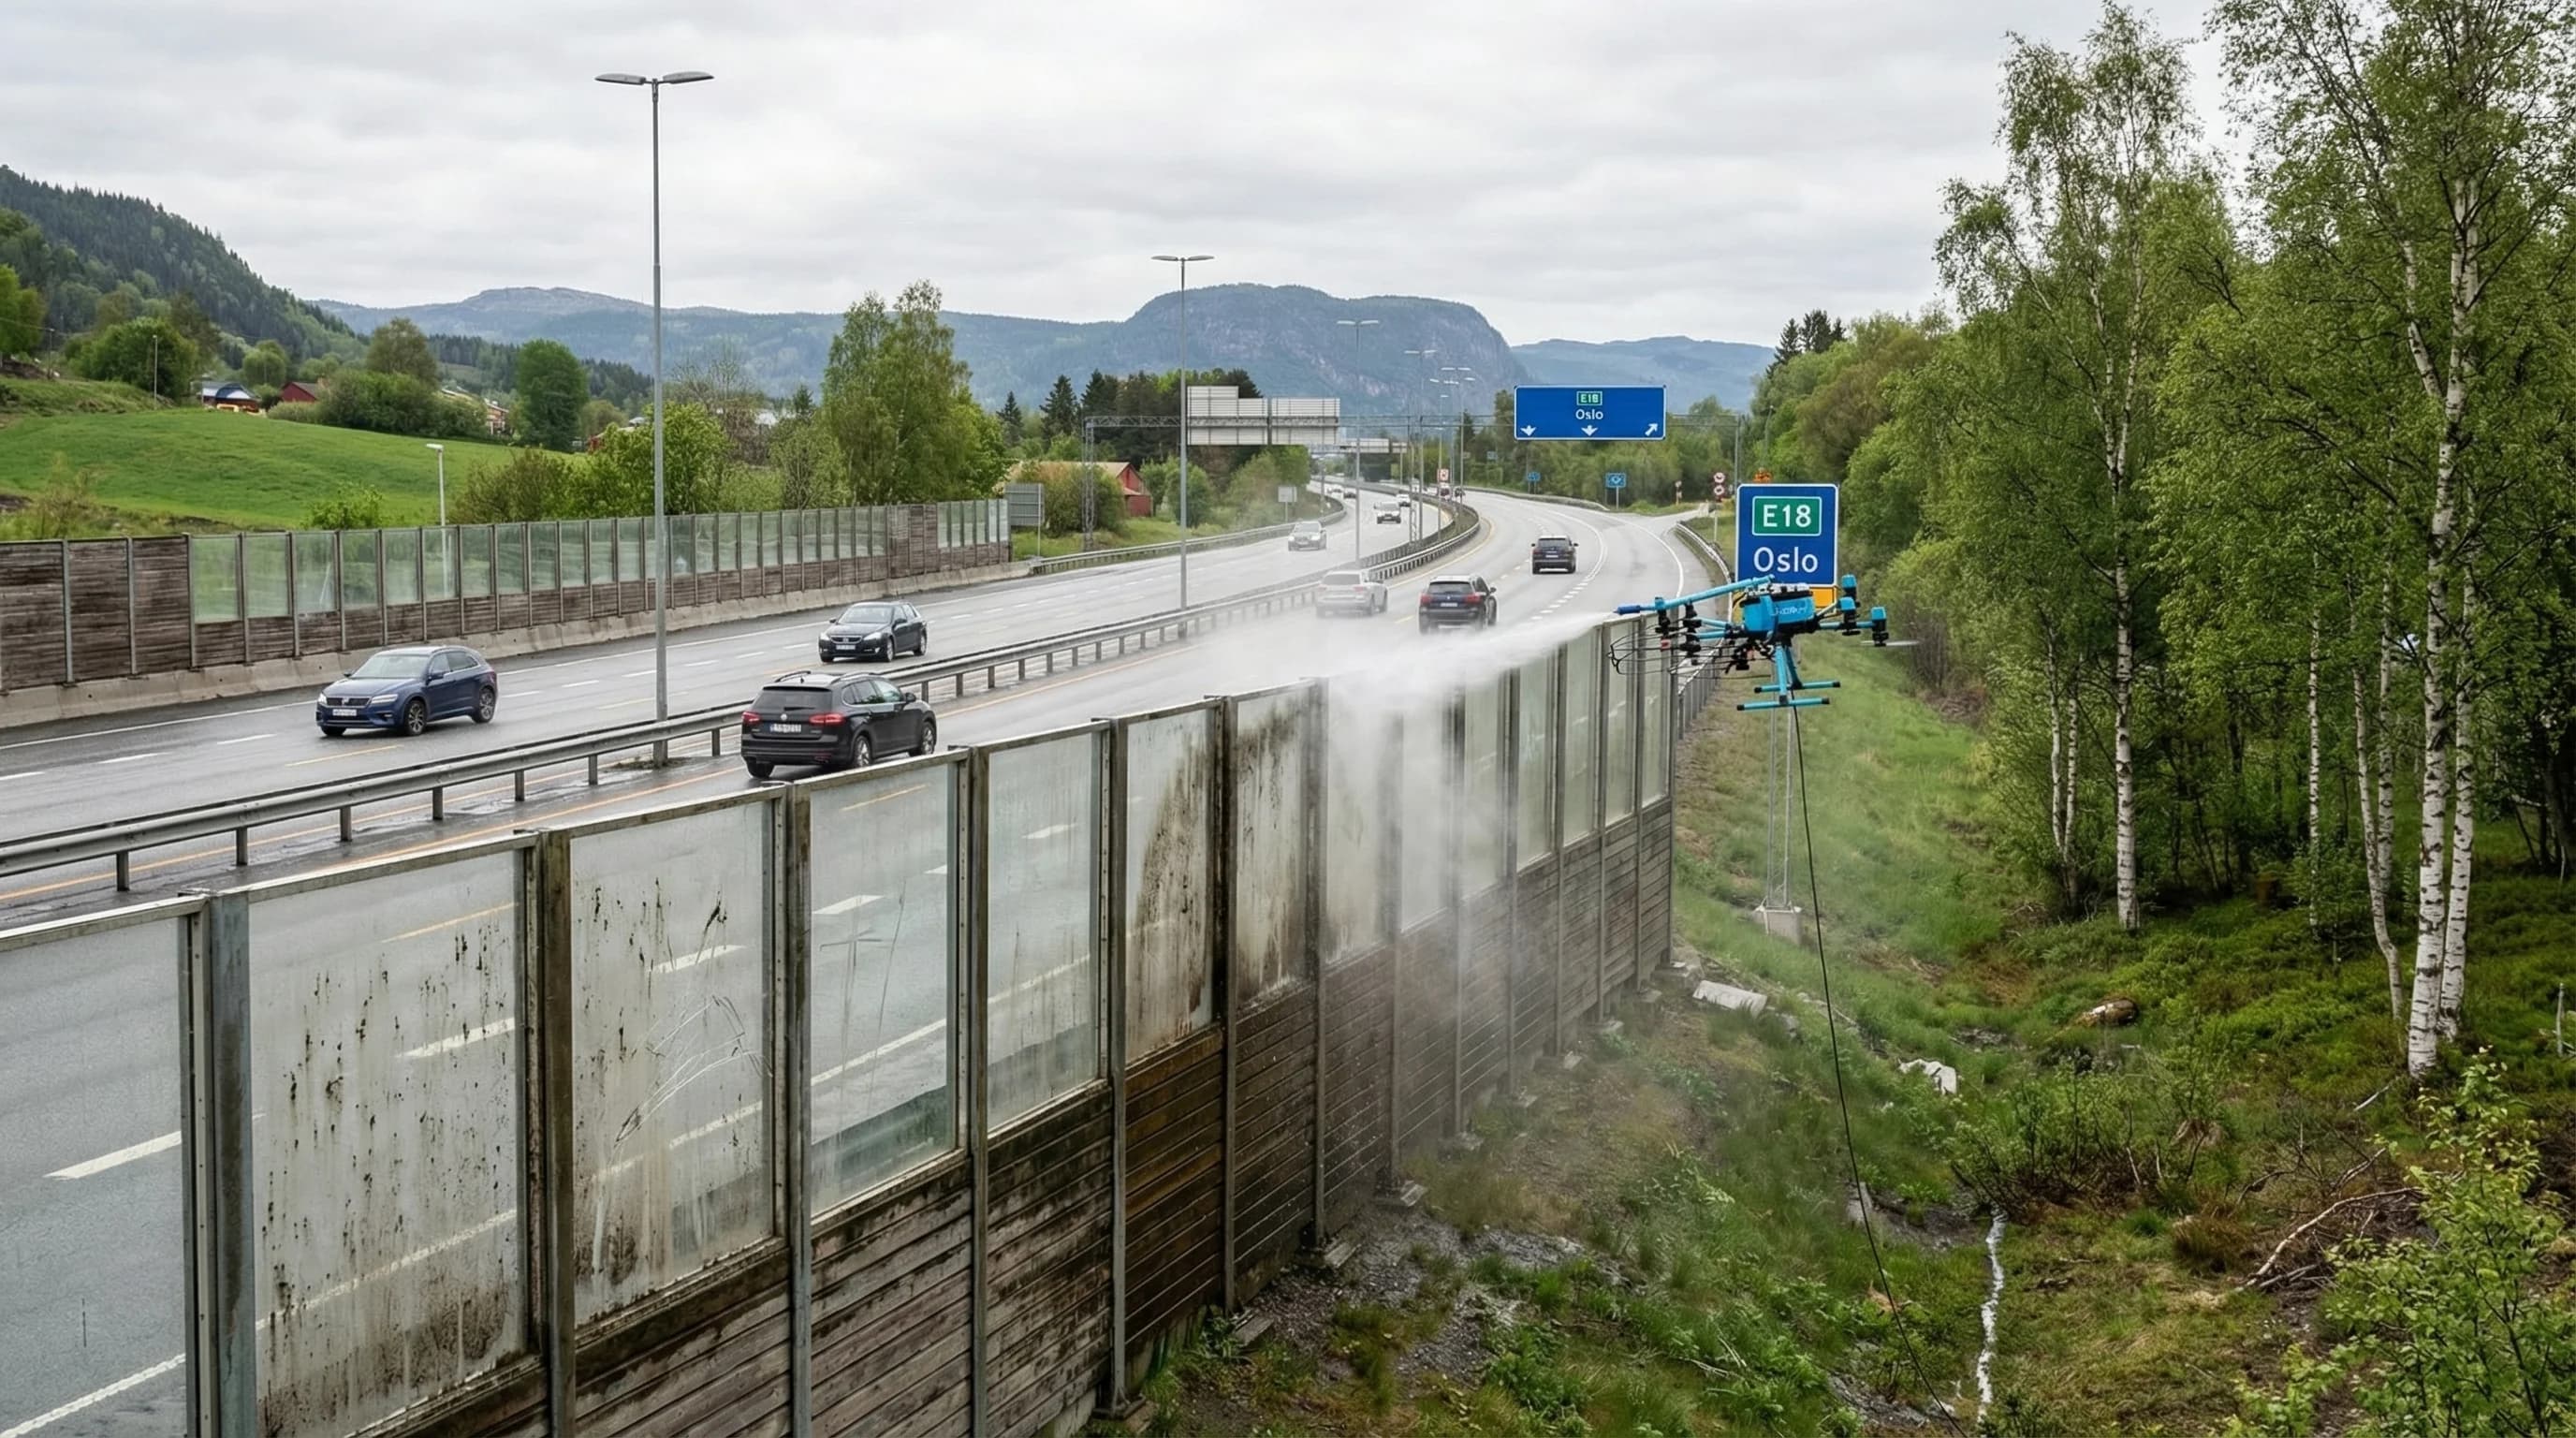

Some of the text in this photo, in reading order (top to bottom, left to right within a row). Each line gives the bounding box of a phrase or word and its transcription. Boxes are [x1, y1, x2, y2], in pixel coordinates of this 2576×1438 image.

[1580, 393, 1599, 403] E18
[1575, 408, 1603, 419] Oslo
[1763, 504, 1811, 527] E18
[1753, 546, 1819, 573] Oslo
